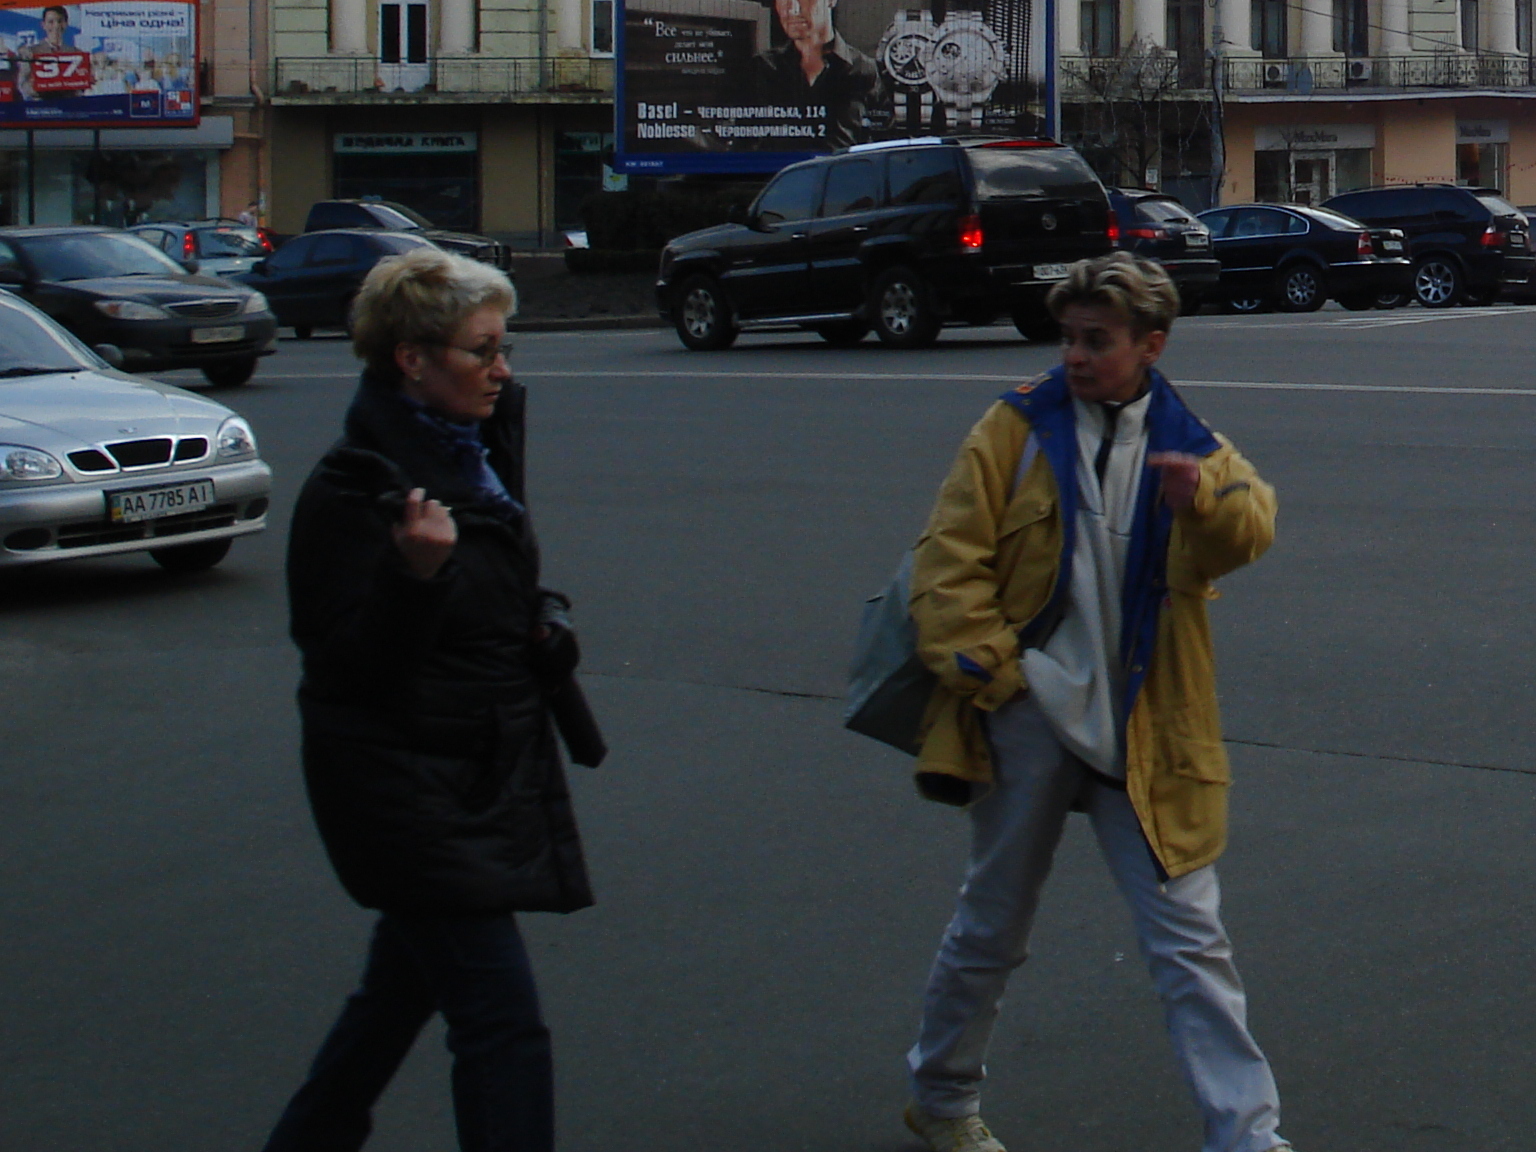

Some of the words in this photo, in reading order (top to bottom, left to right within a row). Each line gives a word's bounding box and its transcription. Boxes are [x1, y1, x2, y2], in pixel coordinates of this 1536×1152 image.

[100, 19, 137, 30] ціна
[139, 18, 185, 30] одна!
[35, 55, 84, 79] 37
[637, 102, 678, 119] Basel
[805, 105, 827, 118] 114
[637, 123, 696, 139] Noblesse
[817, 125, 826, 137] 2
[123, 496, 146, 515] AA
[149, 489, 184, 510] 7785
[188, 486, 206, 504] AI
